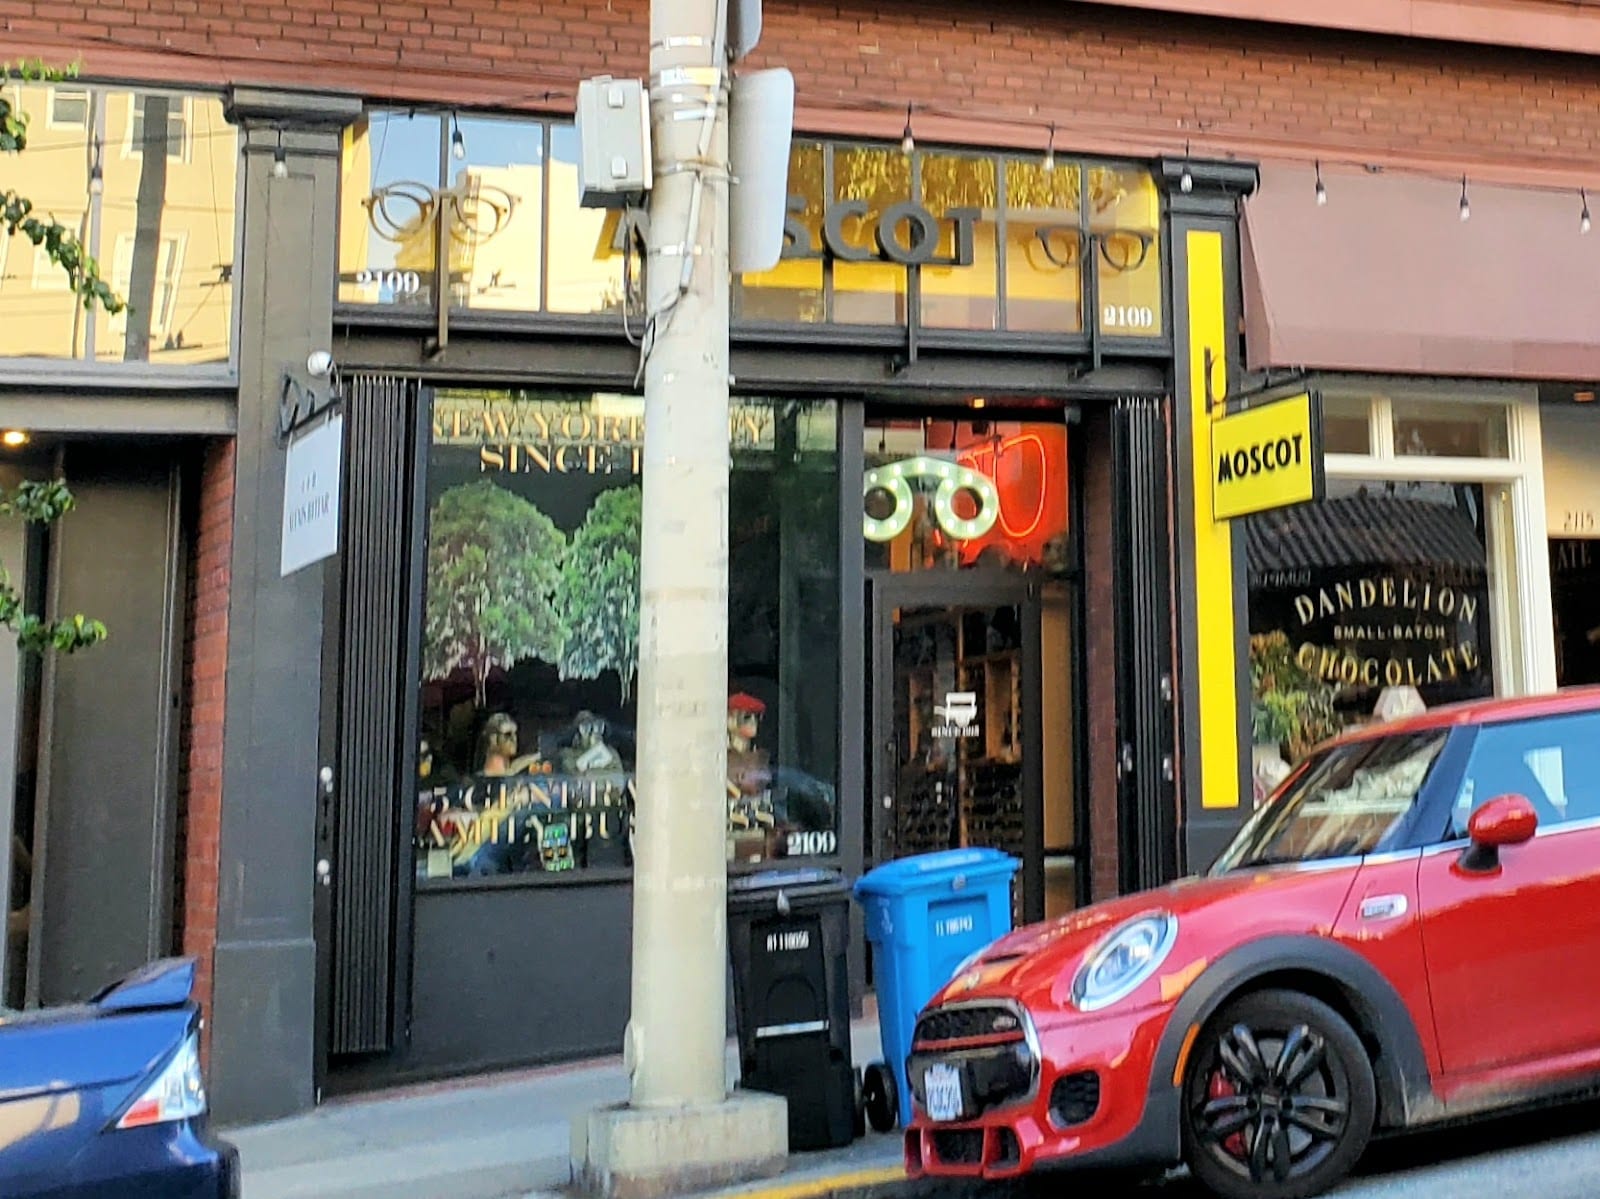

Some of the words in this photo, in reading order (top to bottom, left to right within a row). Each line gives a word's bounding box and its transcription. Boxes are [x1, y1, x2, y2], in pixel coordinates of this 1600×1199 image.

[1103, 304, 1153, 328] 2100
[480, 444, 612, 474] SINCE
[1217, 431, 1303, 485] MOSCOT
[1294, 577, 1477, 626] DANDELION
[1297, 641, 1478, 687] CHOCOLATE
[787, 831, 837, 856] 2100
